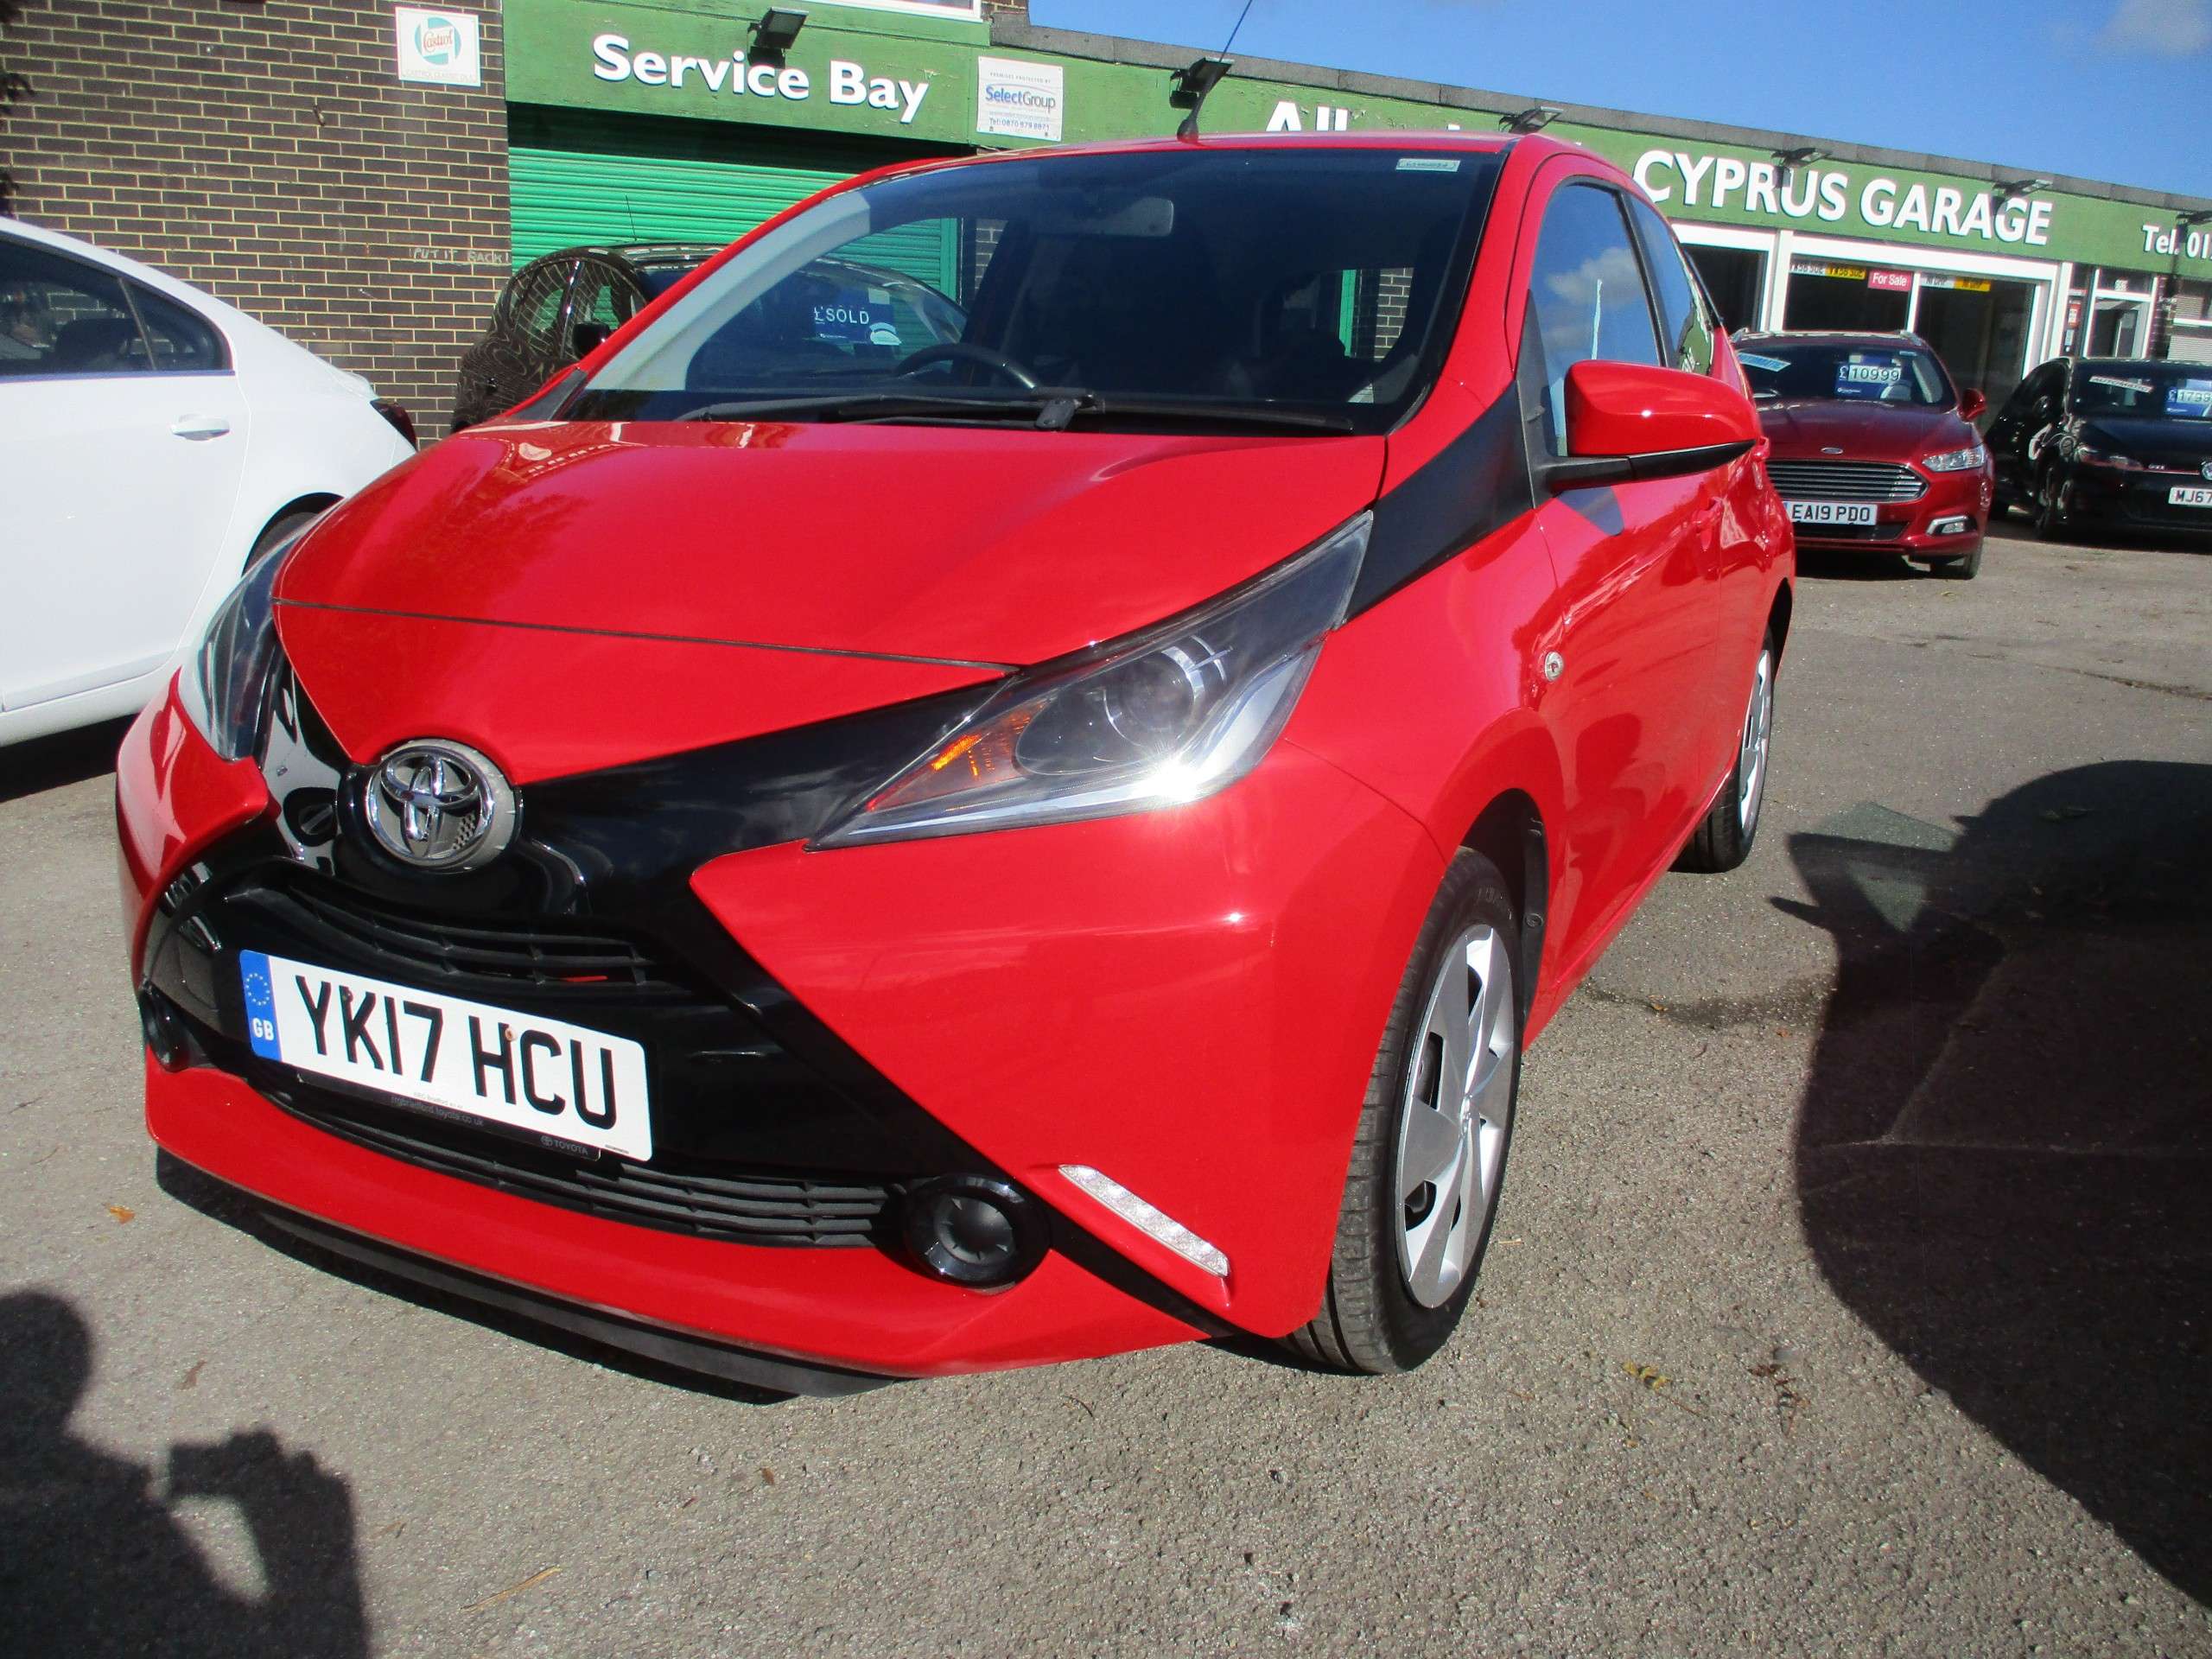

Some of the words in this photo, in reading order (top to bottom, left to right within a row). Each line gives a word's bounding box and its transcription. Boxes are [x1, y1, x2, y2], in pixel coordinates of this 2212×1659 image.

[593, 34, 810, 100] Service
[830, 60, 929, 124] Bay
[1633, 149, 1848, 222] CYPRUS
[1859, 177, 2053, 246] GARAGE
[2186, 231, 2212, 260] 01
[1872, 273, 1888, 285] For
[1889, 275, 1908, 287] Sale
[1791, 504, 1830, 520] EA19
[1836, 506, 1871, 522] PDO
[252, 1018, 275, 1041] GB
[295, 975, 443, 1084] YK17
[468, 1015, 617, 1130] HCU
[553, 1139, 589, 1156] TOYOTA
